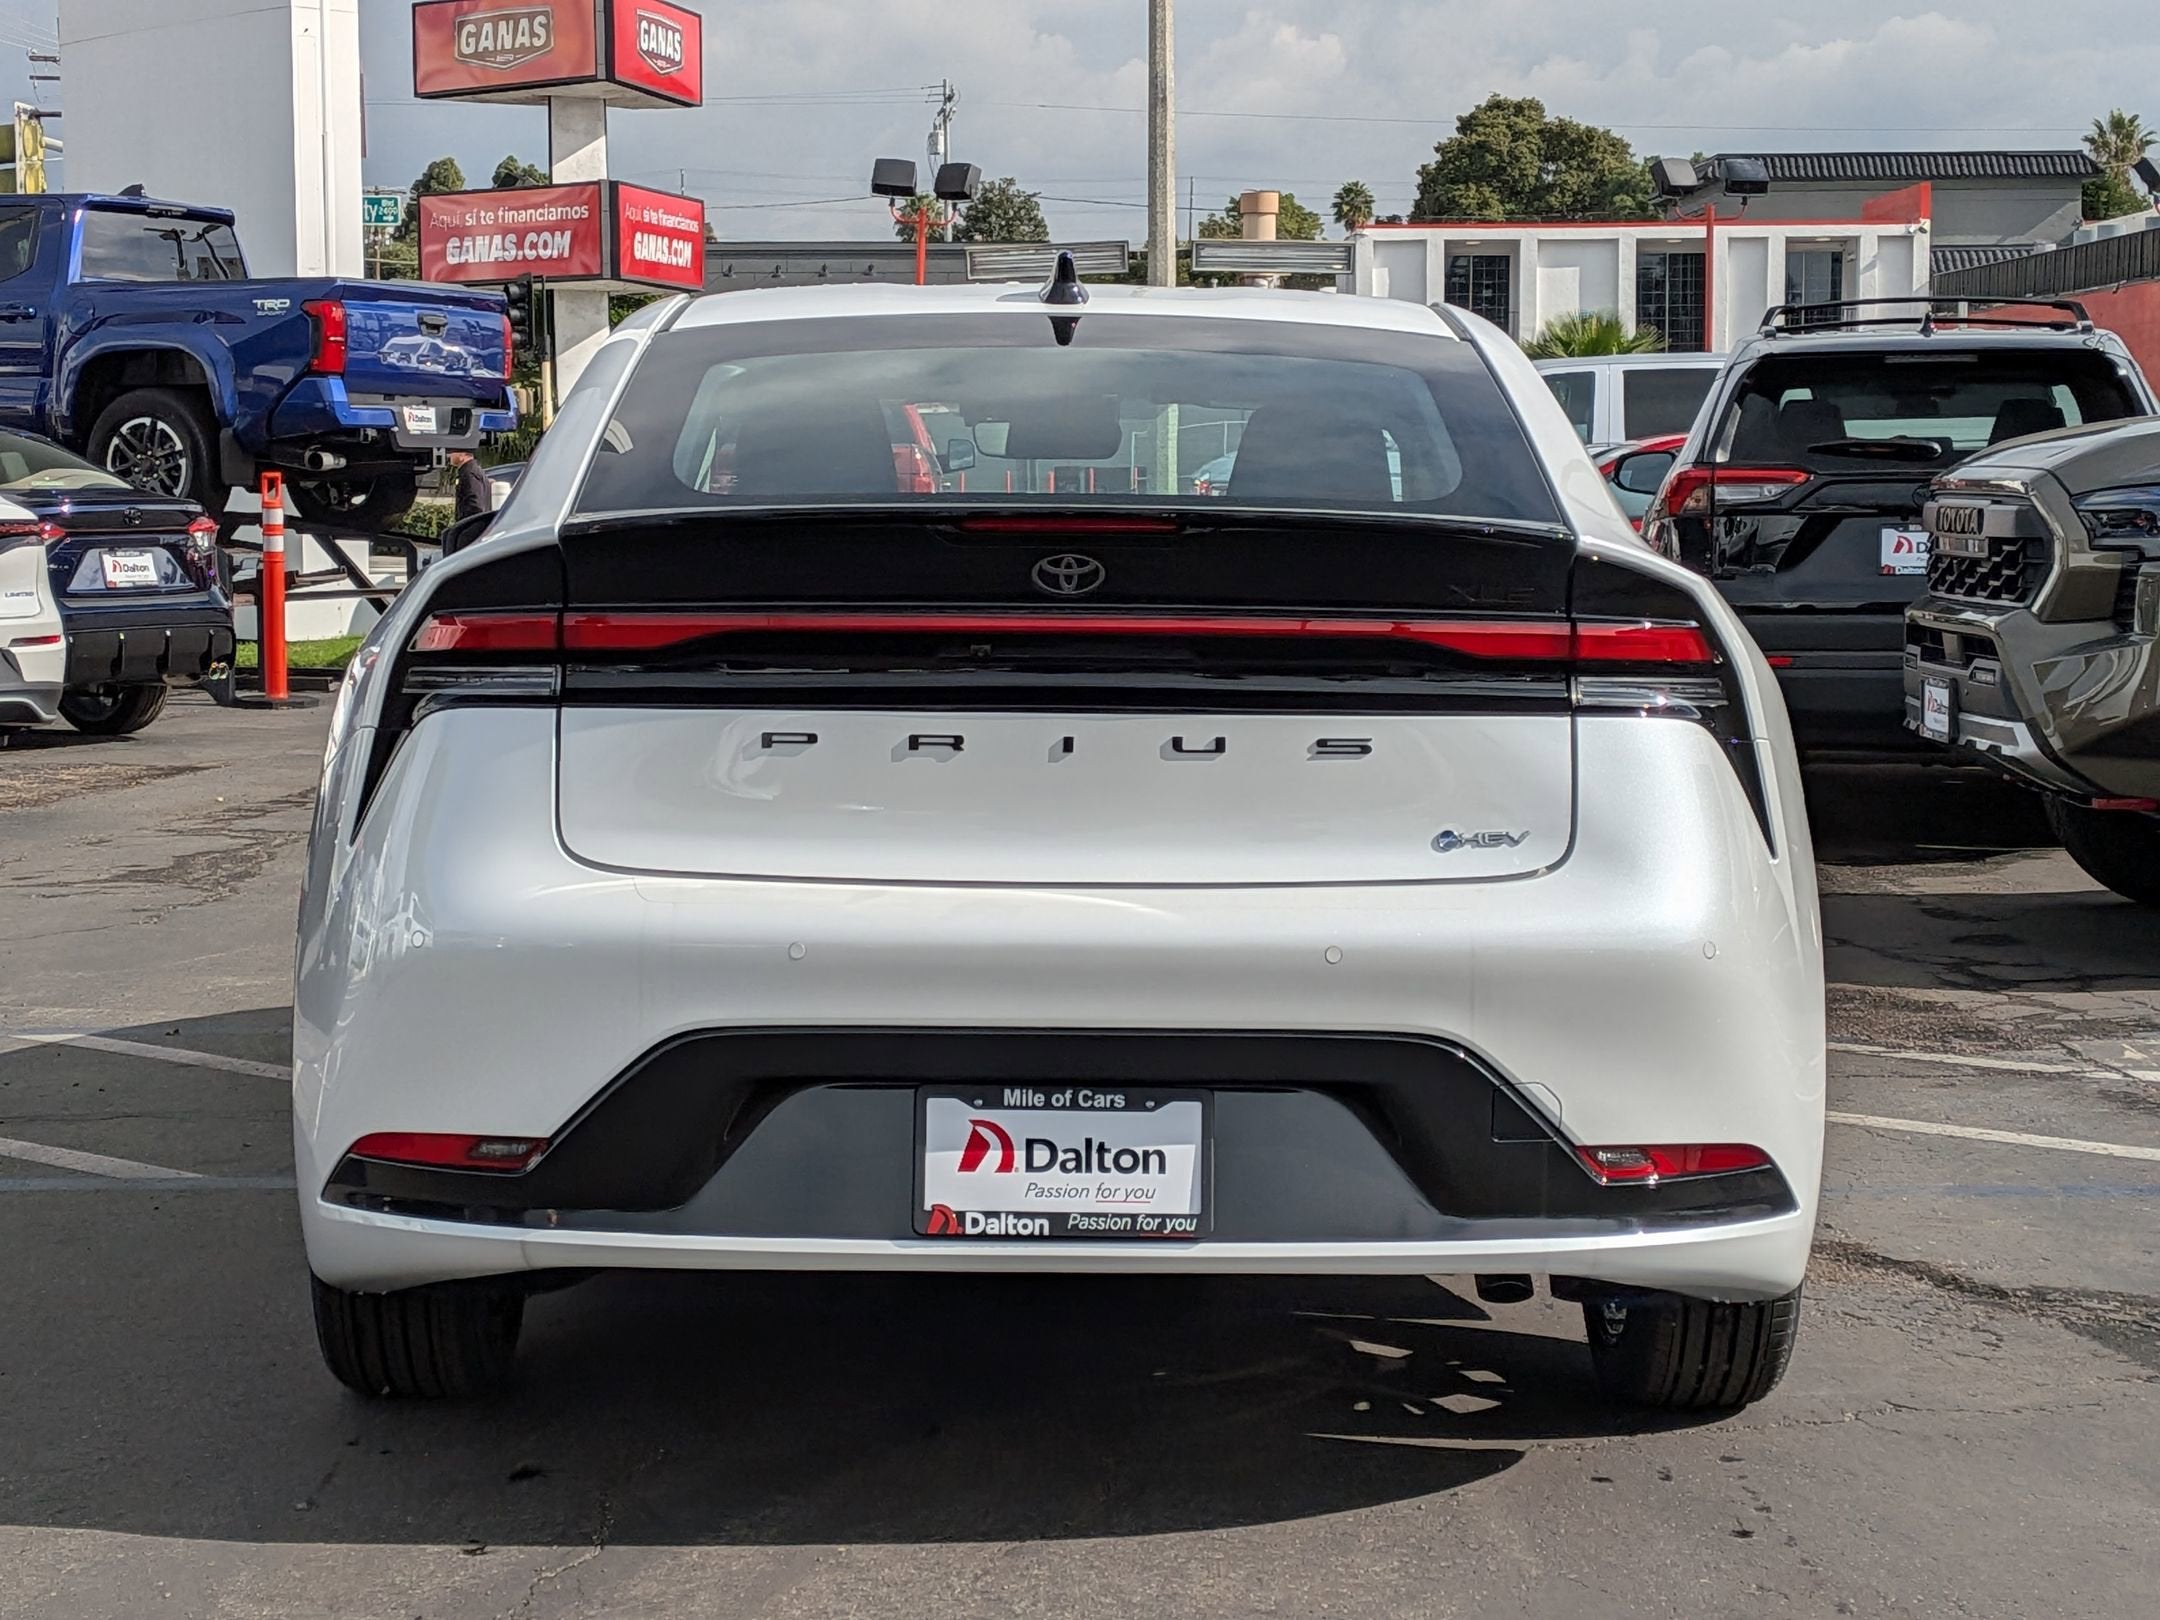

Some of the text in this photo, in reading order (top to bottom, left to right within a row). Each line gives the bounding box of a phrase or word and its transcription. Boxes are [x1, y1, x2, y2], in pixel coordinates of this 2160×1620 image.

[460, 15, 547, 55] GANAS
[639, 19, 681, 61] GANAS
[480, 209, 495, 226] te
[498, 203, 589, 225] financiamos
[658, 208, 699, 233] financiamos
[446, 229, 572, 265] GANAS.COM
[633, 231, 693, 269] GANAS.COM
[252, 298, 290, 311] TRD
[1939, 507, 1978, 535] TOYOTA
[122, 564, 149, 573] Dalton
[761, 732, 1373, 755] PRIUS
[1003, 1088, 1126, 1109] Mile of Cars
[1024, 1137, 1167, 1175] Dalton
[1024, 1182, 1156, 1202] Passion for you
[964, 1212, 1197, 1235] Dalton Passion for you
